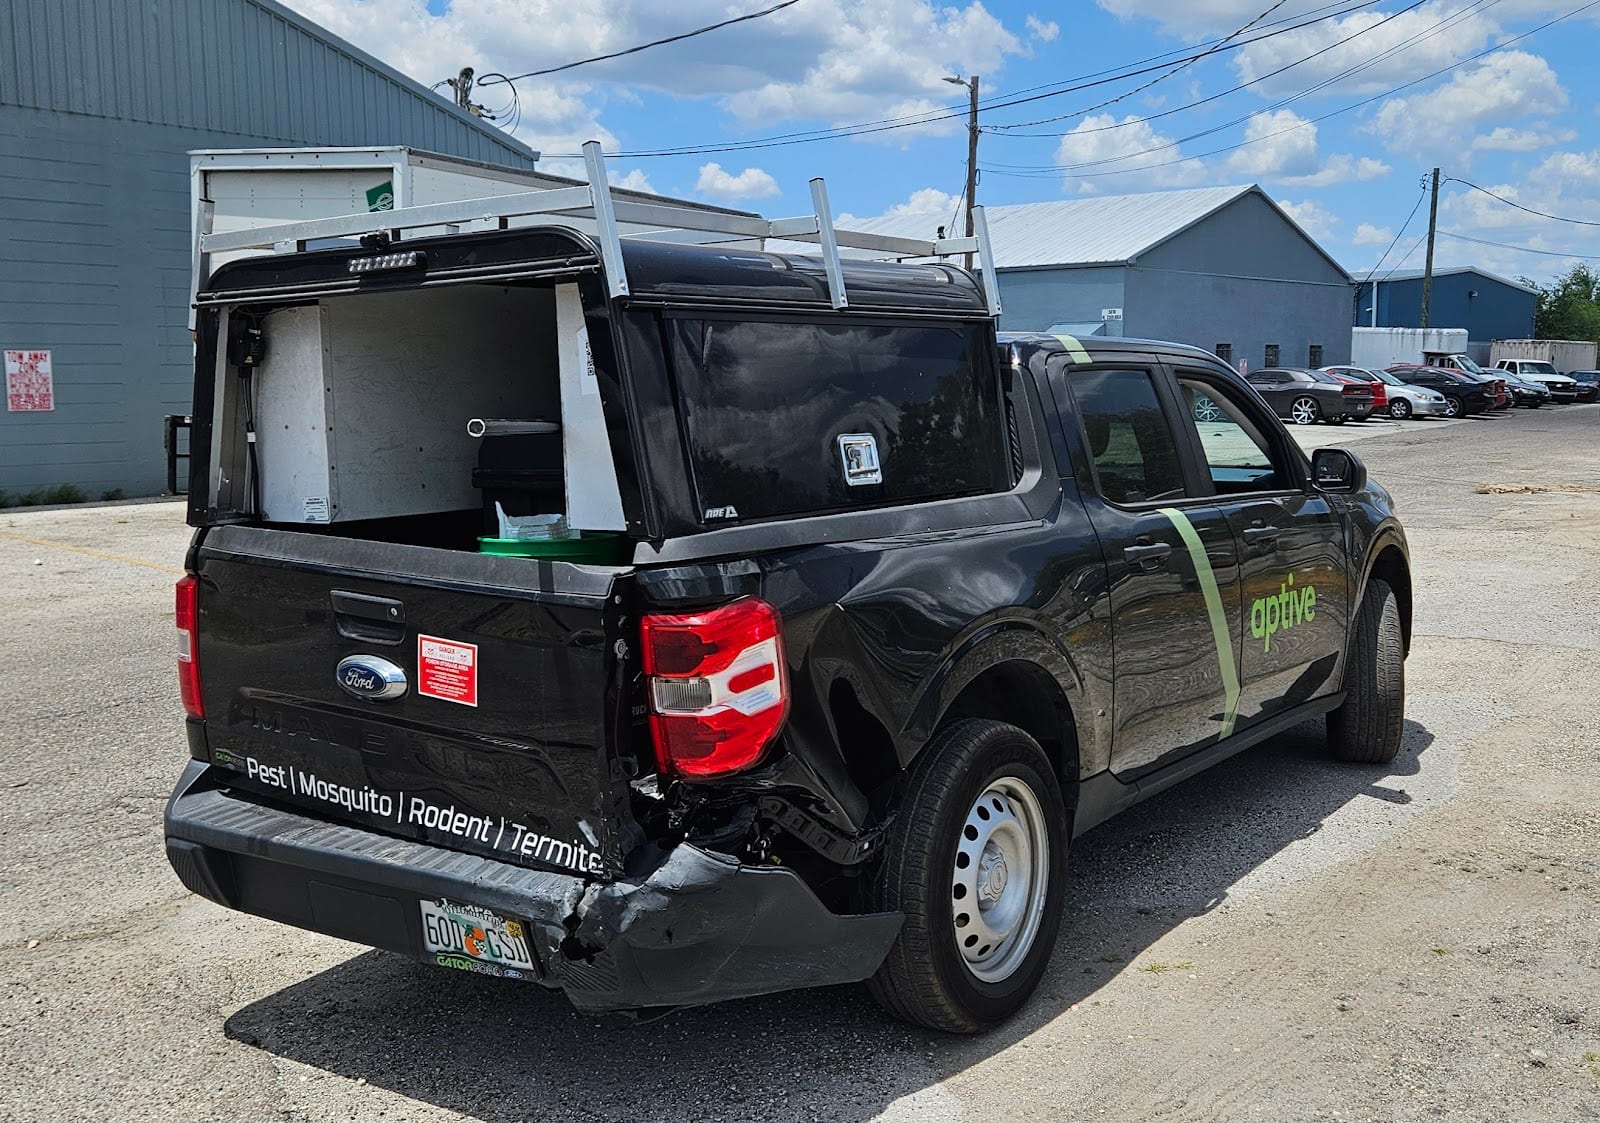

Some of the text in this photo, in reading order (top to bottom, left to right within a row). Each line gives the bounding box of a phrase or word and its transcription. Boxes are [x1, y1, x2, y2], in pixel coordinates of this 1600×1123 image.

[1250, 573, 1317, 653] aptive
[345, 668, 375, 690] Ford
[246, 756, 604, 874] Pest Mosquito Rodent Termite
